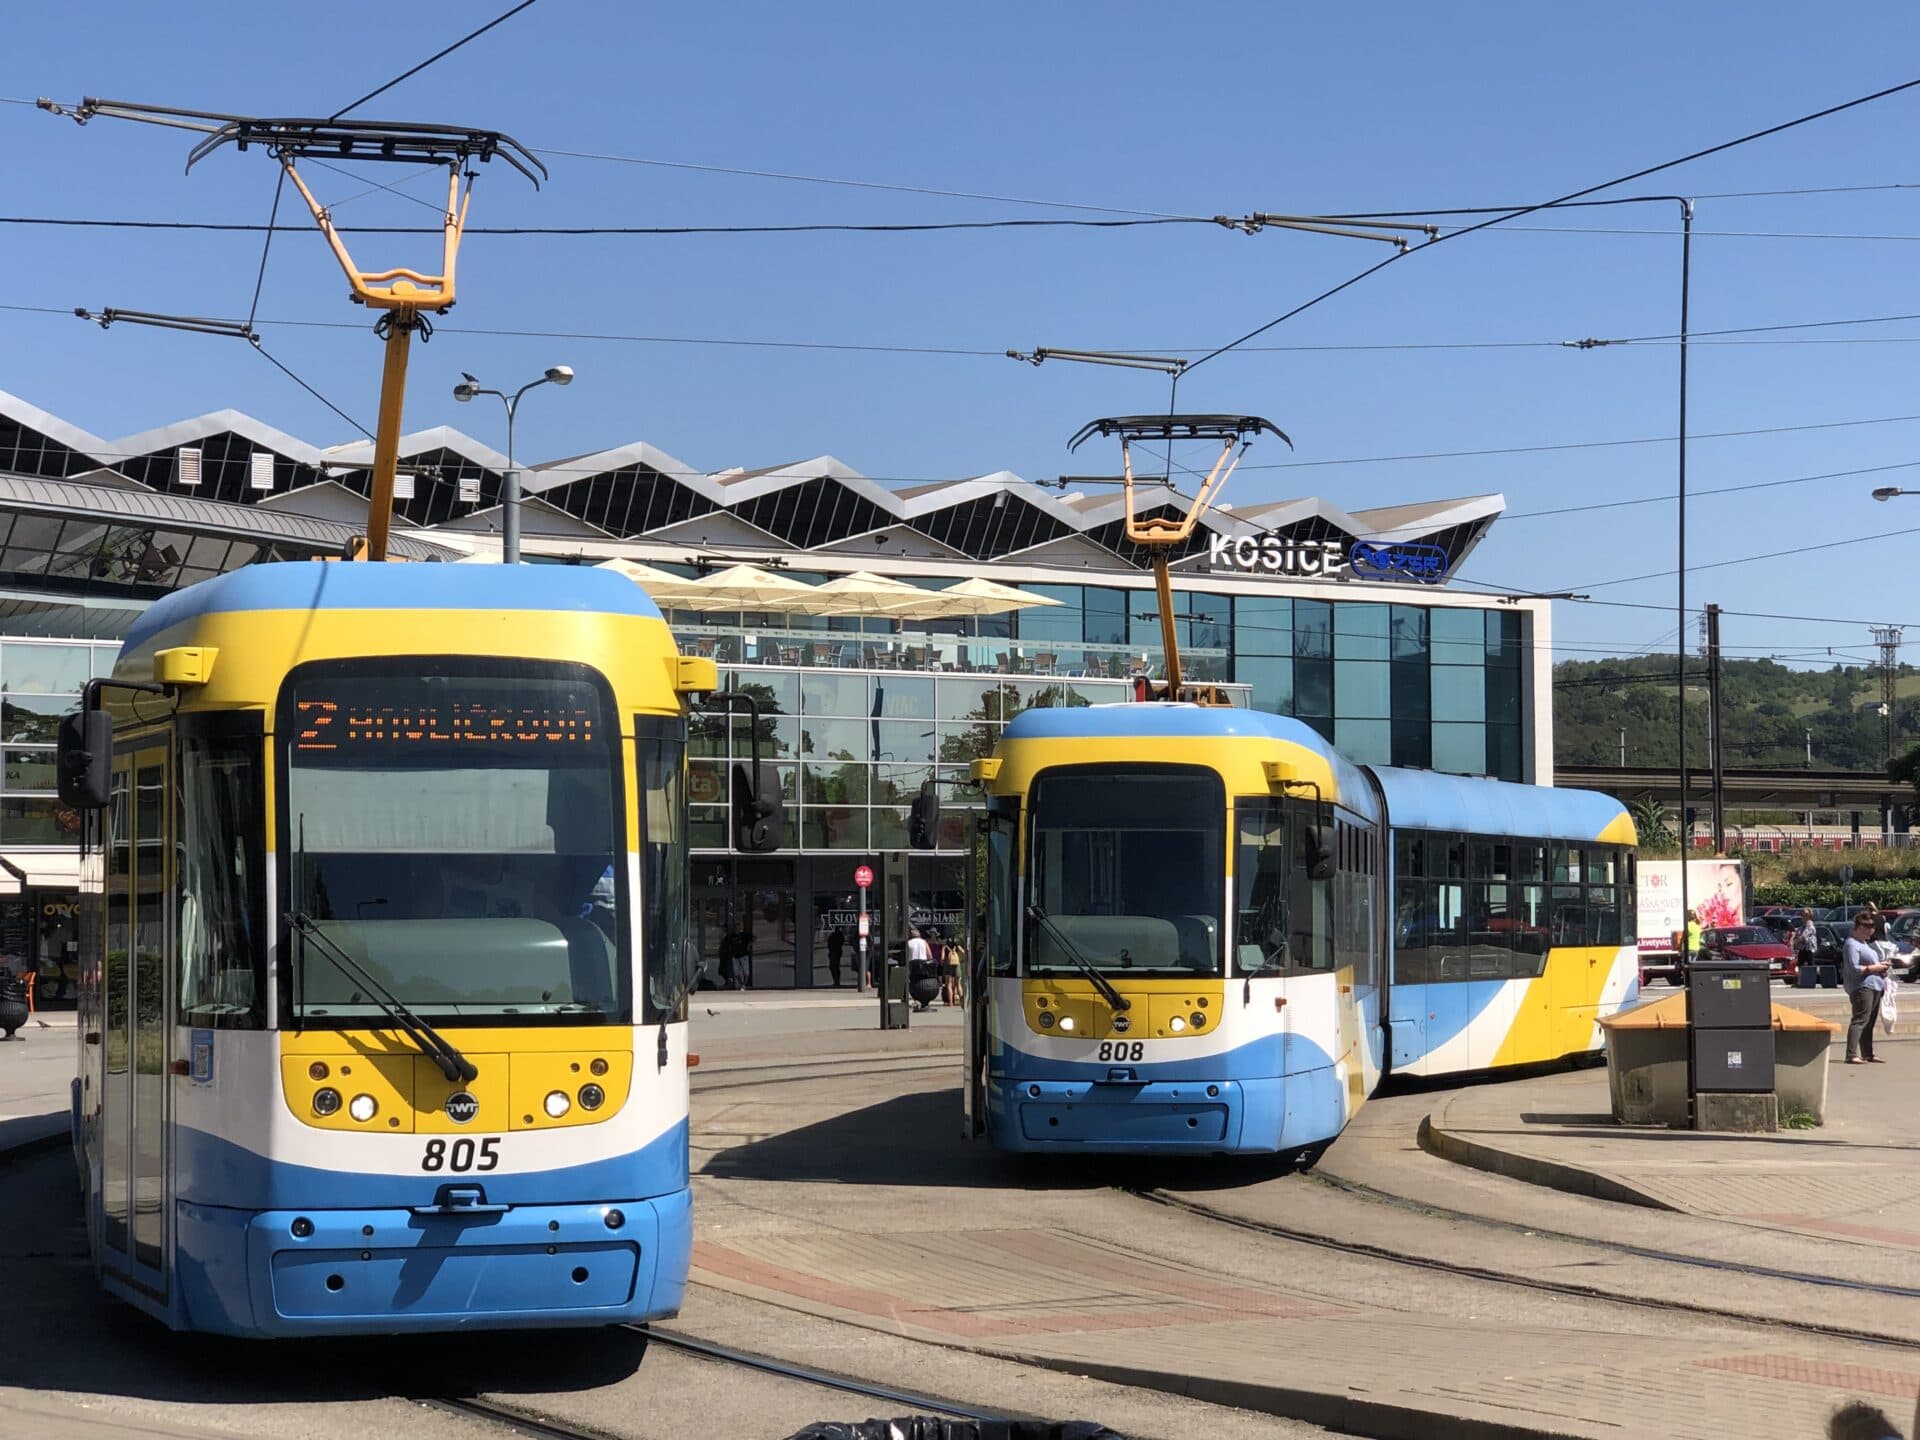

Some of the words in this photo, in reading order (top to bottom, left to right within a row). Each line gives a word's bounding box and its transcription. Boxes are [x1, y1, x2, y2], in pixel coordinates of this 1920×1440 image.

[298, 702, 338, 748] 2
[1098, 1041, 1144, 1061] 808
[446, 1103, 478, 1113] TWT
[421, 1137, 502, 1173] 805
